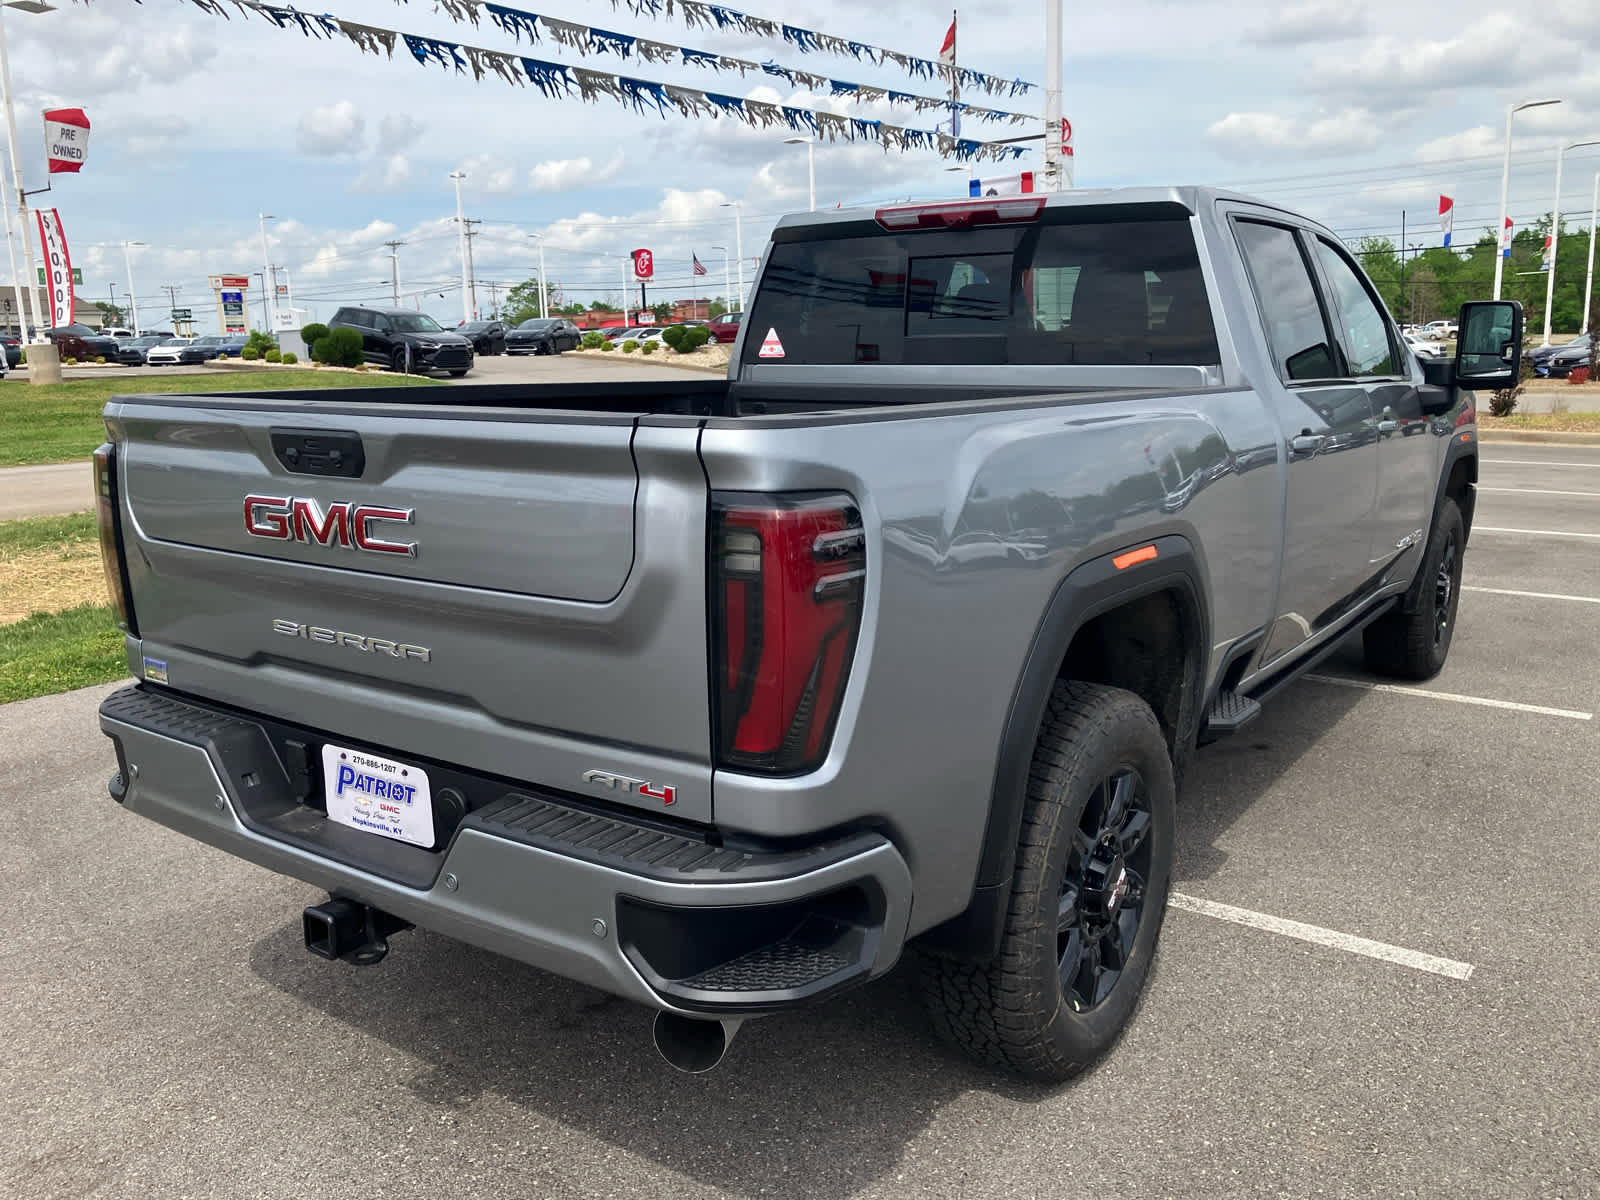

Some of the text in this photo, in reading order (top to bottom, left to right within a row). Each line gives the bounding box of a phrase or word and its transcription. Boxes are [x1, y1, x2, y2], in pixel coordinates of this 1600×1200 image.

[60, 128, 76, 141] PRE
[53, 144, 82, 159] OWNED
[43, 215, 63, 320] $10,000
[243, 494, 419, 560] GMC
[271, 619, 432, 663] SIERRA
[352, 755, 397, 774] 270-886-1207
[337, 764, 416, 804] PATRIOT
[583, 769, 678, 807] AT4
[380, 804, 400, 814] GMC
[393, 826, 403, 836] KY
